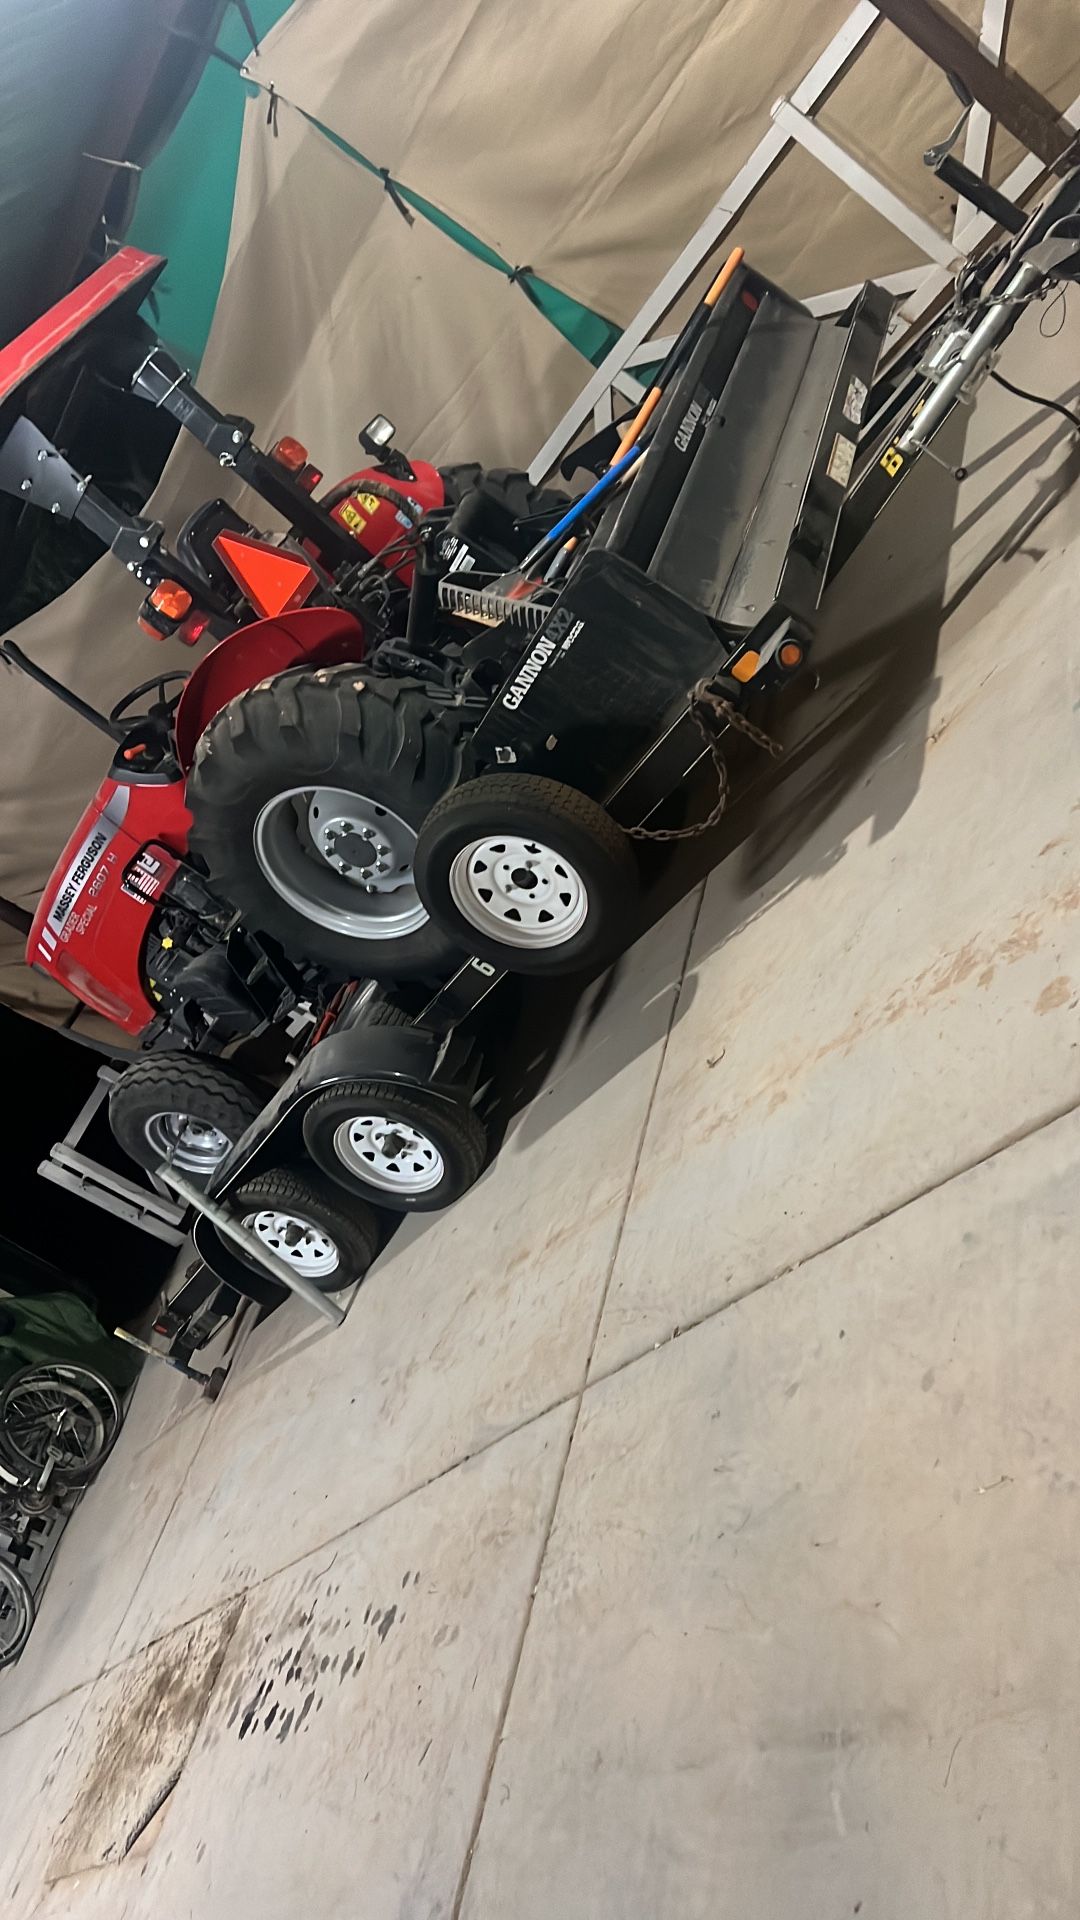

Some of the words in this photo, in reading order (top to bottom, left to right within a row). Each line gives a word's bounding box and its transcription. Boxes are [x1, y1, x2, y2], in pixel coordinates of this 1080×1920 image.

[674, 399, 703, 452] GANNON
[502, 635, 557, 710] GANNON
[53, 882, 77, 923] MASSEY
[71, 831, 108, 886] FERGUSON
[88, 864, 111, 897] 2607
[107, 852, 118, 864] H
[76, 903, 98, 935] SPECIAL
